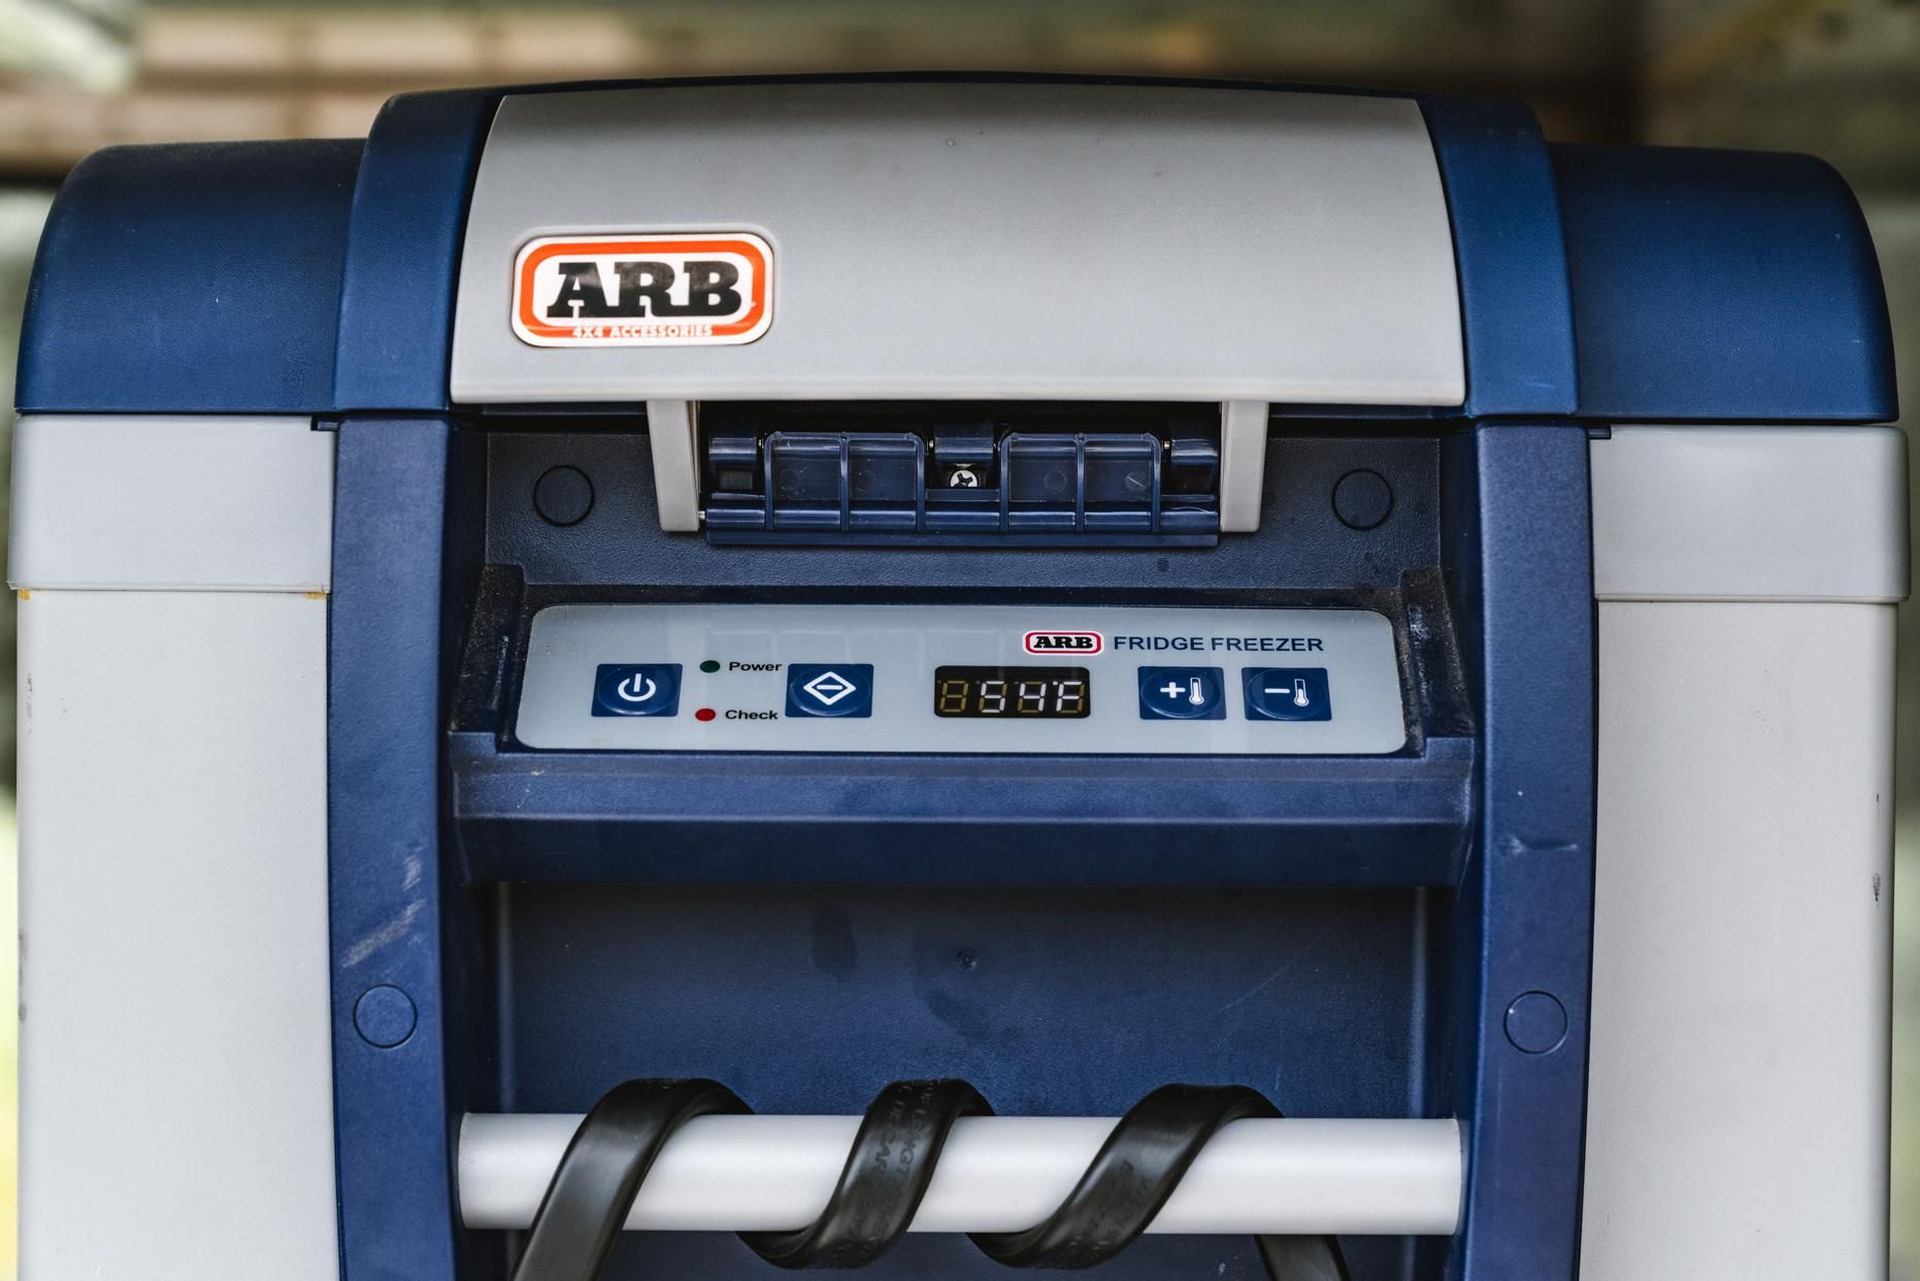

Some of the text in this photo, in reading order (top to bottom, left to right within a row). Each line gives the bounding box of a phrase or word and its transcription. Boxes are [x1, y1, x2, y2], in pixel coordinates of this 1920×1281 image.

[546, 260, 742, 318] ARB
[609, 324, 713, 337] ACCESSORIES
[1033, 635, 1094, 649] ARB
[1113, 636, 1325, 652] FRIDGE FREEZER
[728, 661, 782, 672] Power
[725, 709, 778, 721] Check
